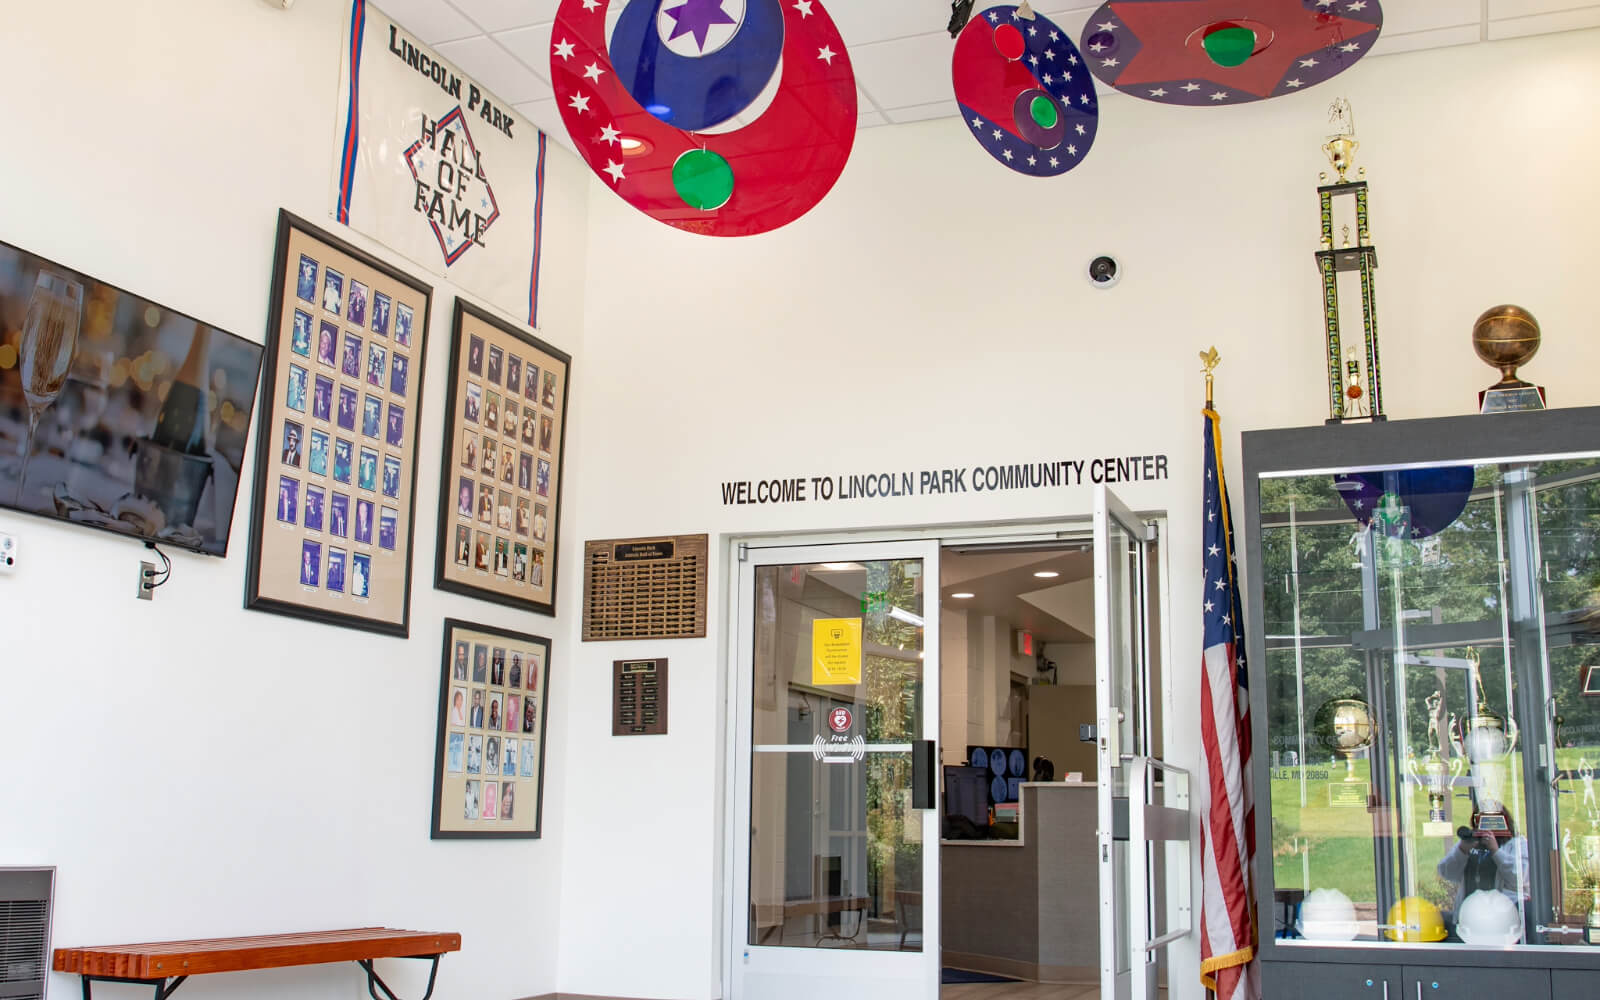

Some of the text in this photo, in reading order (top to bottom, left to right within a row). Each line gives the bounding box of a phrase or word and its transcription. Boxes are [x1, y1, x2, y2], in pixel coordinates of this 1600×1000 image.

[389, 24, 514, 139] LINCOLN PARK
[420, 113, 487, 183] HALL
[438, 160, 470, 201] OF
[414, 179, 487, 248] FAME
[722, 455, 1168, 505] WELCOME TO LINCOLN PARK COMMUNITY CENTER
